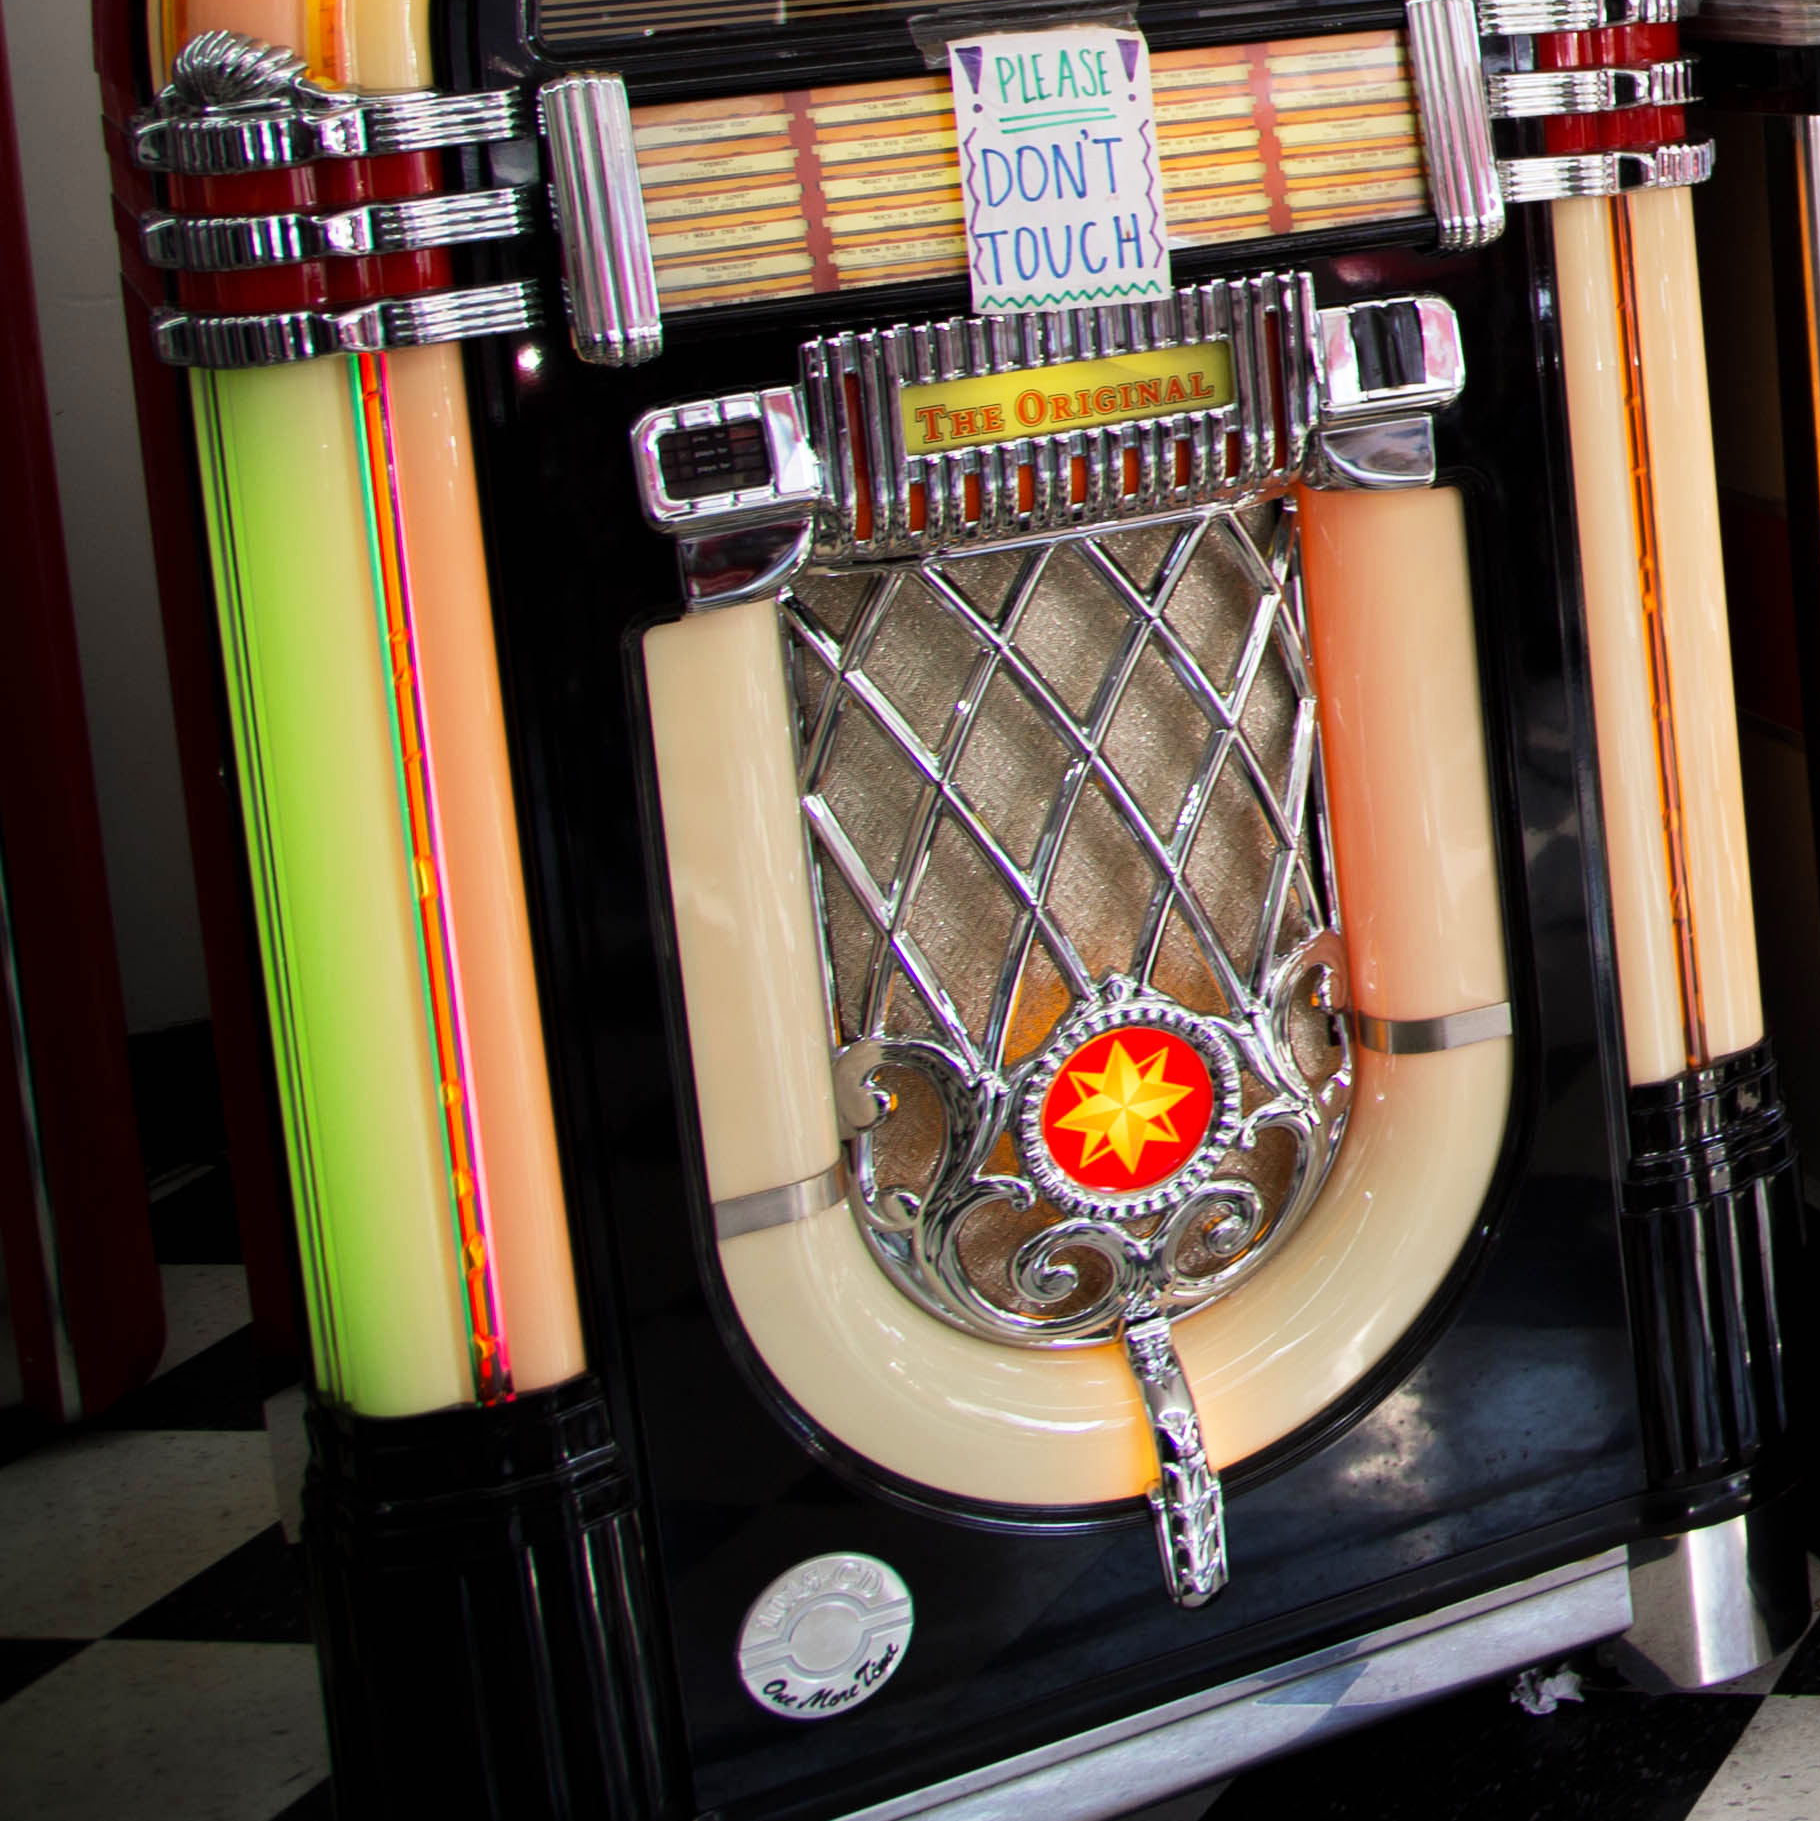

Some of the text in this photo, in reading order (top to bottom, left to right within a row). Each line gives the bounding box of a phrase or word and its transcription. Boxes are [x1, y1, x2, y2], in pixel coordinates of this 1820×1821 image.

[996, 47, 1113, 105] PLEASE
[979, 129, 1126, 209] DON'T
[977, 214, 1146, 287] TOUCH
